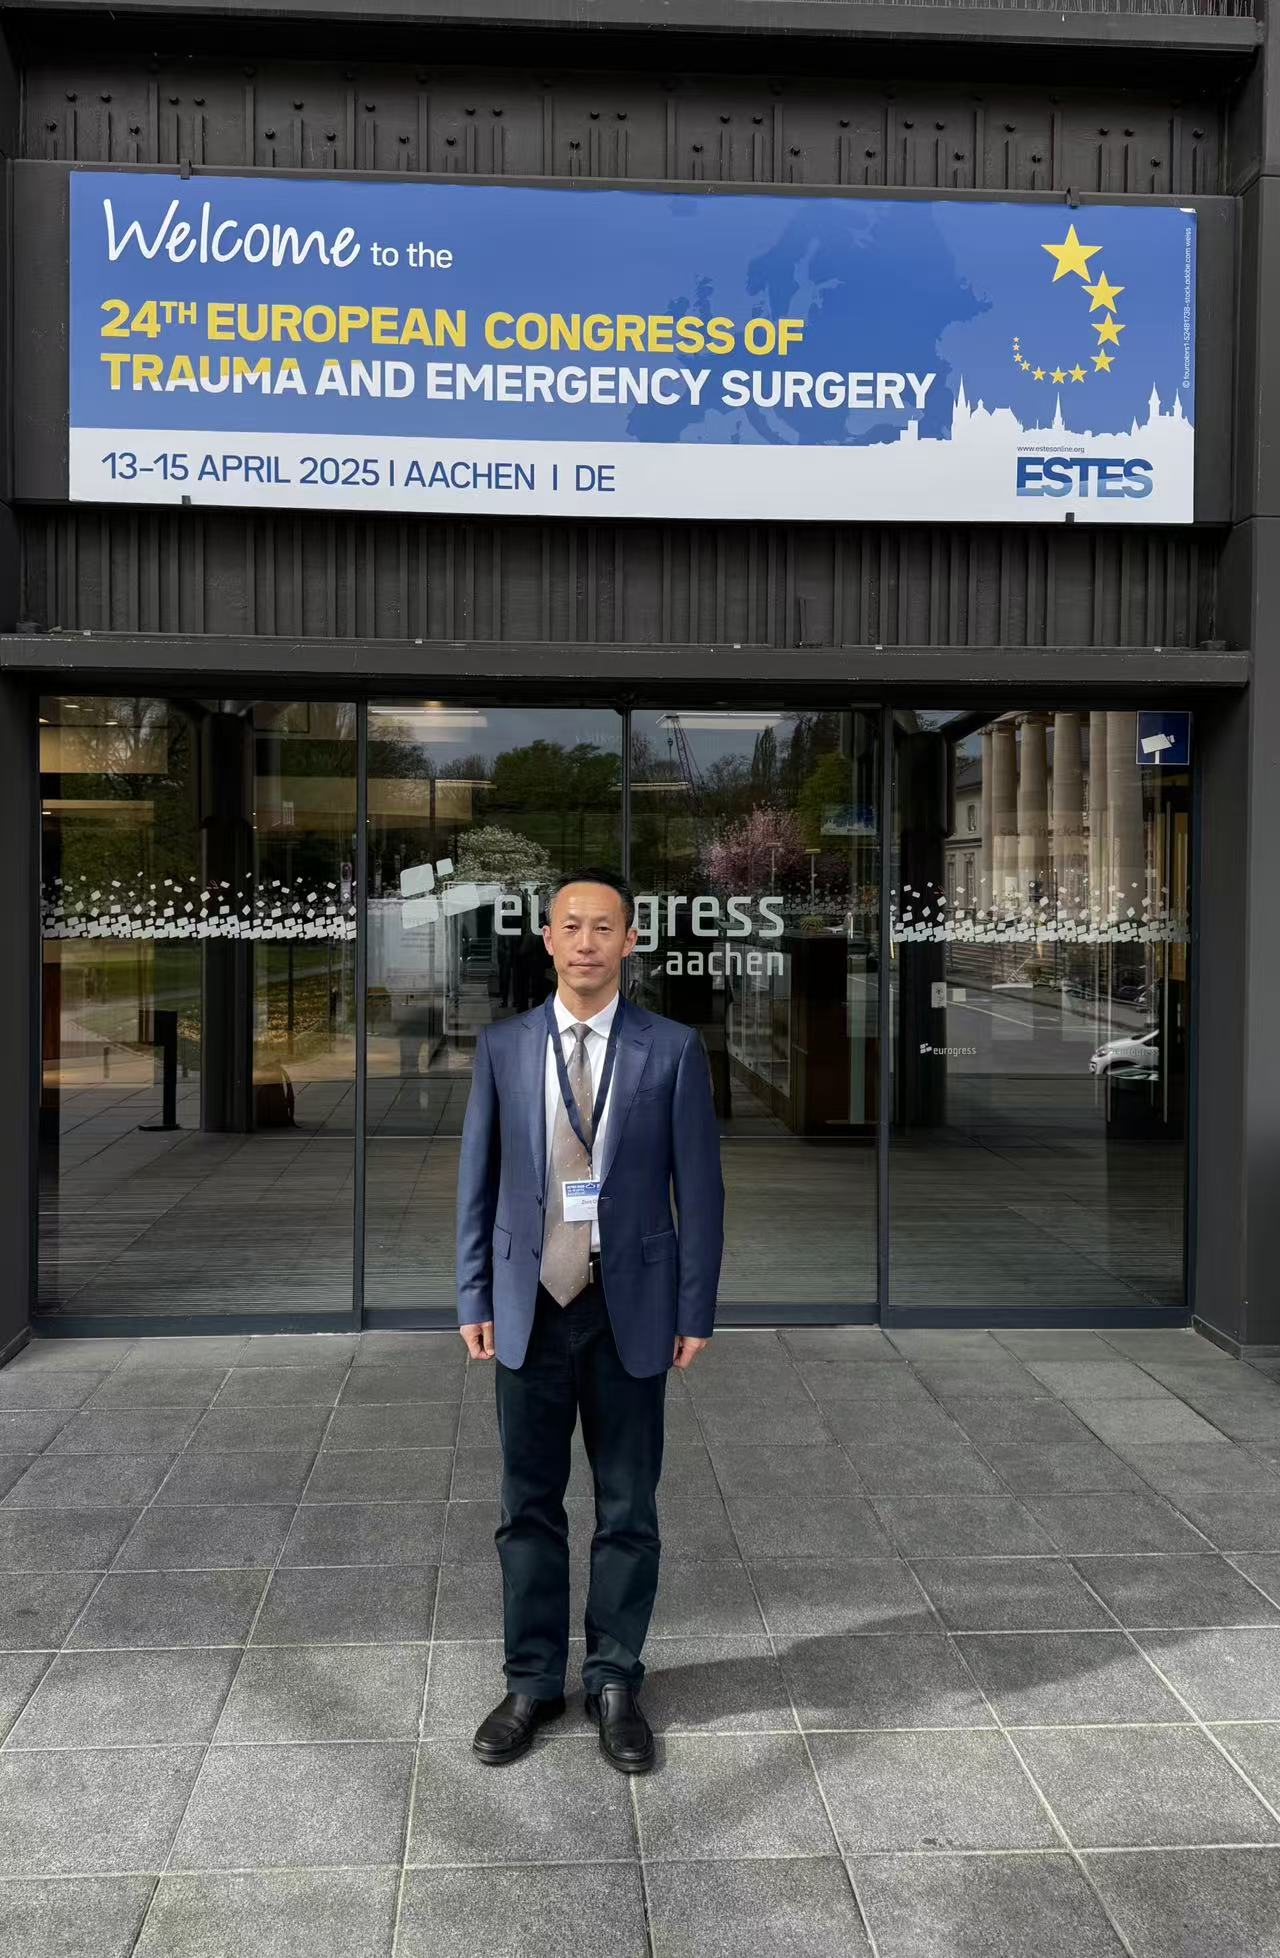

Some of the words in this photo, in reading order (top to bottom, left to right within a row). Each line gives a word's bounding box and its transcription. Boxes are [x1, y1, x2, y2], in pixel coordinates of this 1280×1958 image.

[103, 198, 361, 268] Welcome
[370, 243, 399, 267] to
[406, 241, 453, 269] the
[100, 298, 197, 339] 24TH
[207, 302, 467, 348] EUROPEAN
[484, 311, 736, 356] CONGRESS
[744, 317, 805, 356] OF
[100, 352, 308, 396] TRAUMA
[314, 358, 416, 399] AND
[426, 361, 712, 407] EMERGENCY
[721, 369, 937, 409] SURGERY
[1016, 445, 1085, 453] www.estesonline.org
[197, 454, 293, 484] APRIL
[299, 456, 380, 487] 2025
[403, 460, 536, 491] AACHEN
[575, 464, 616, 492] DE
[1016, 456, 1154, 498] ESTES
[494, 894, 785, 953] eugress
[665, 942, 784, 976] aachen
[933, 1047, 977, 1057] eurogress
